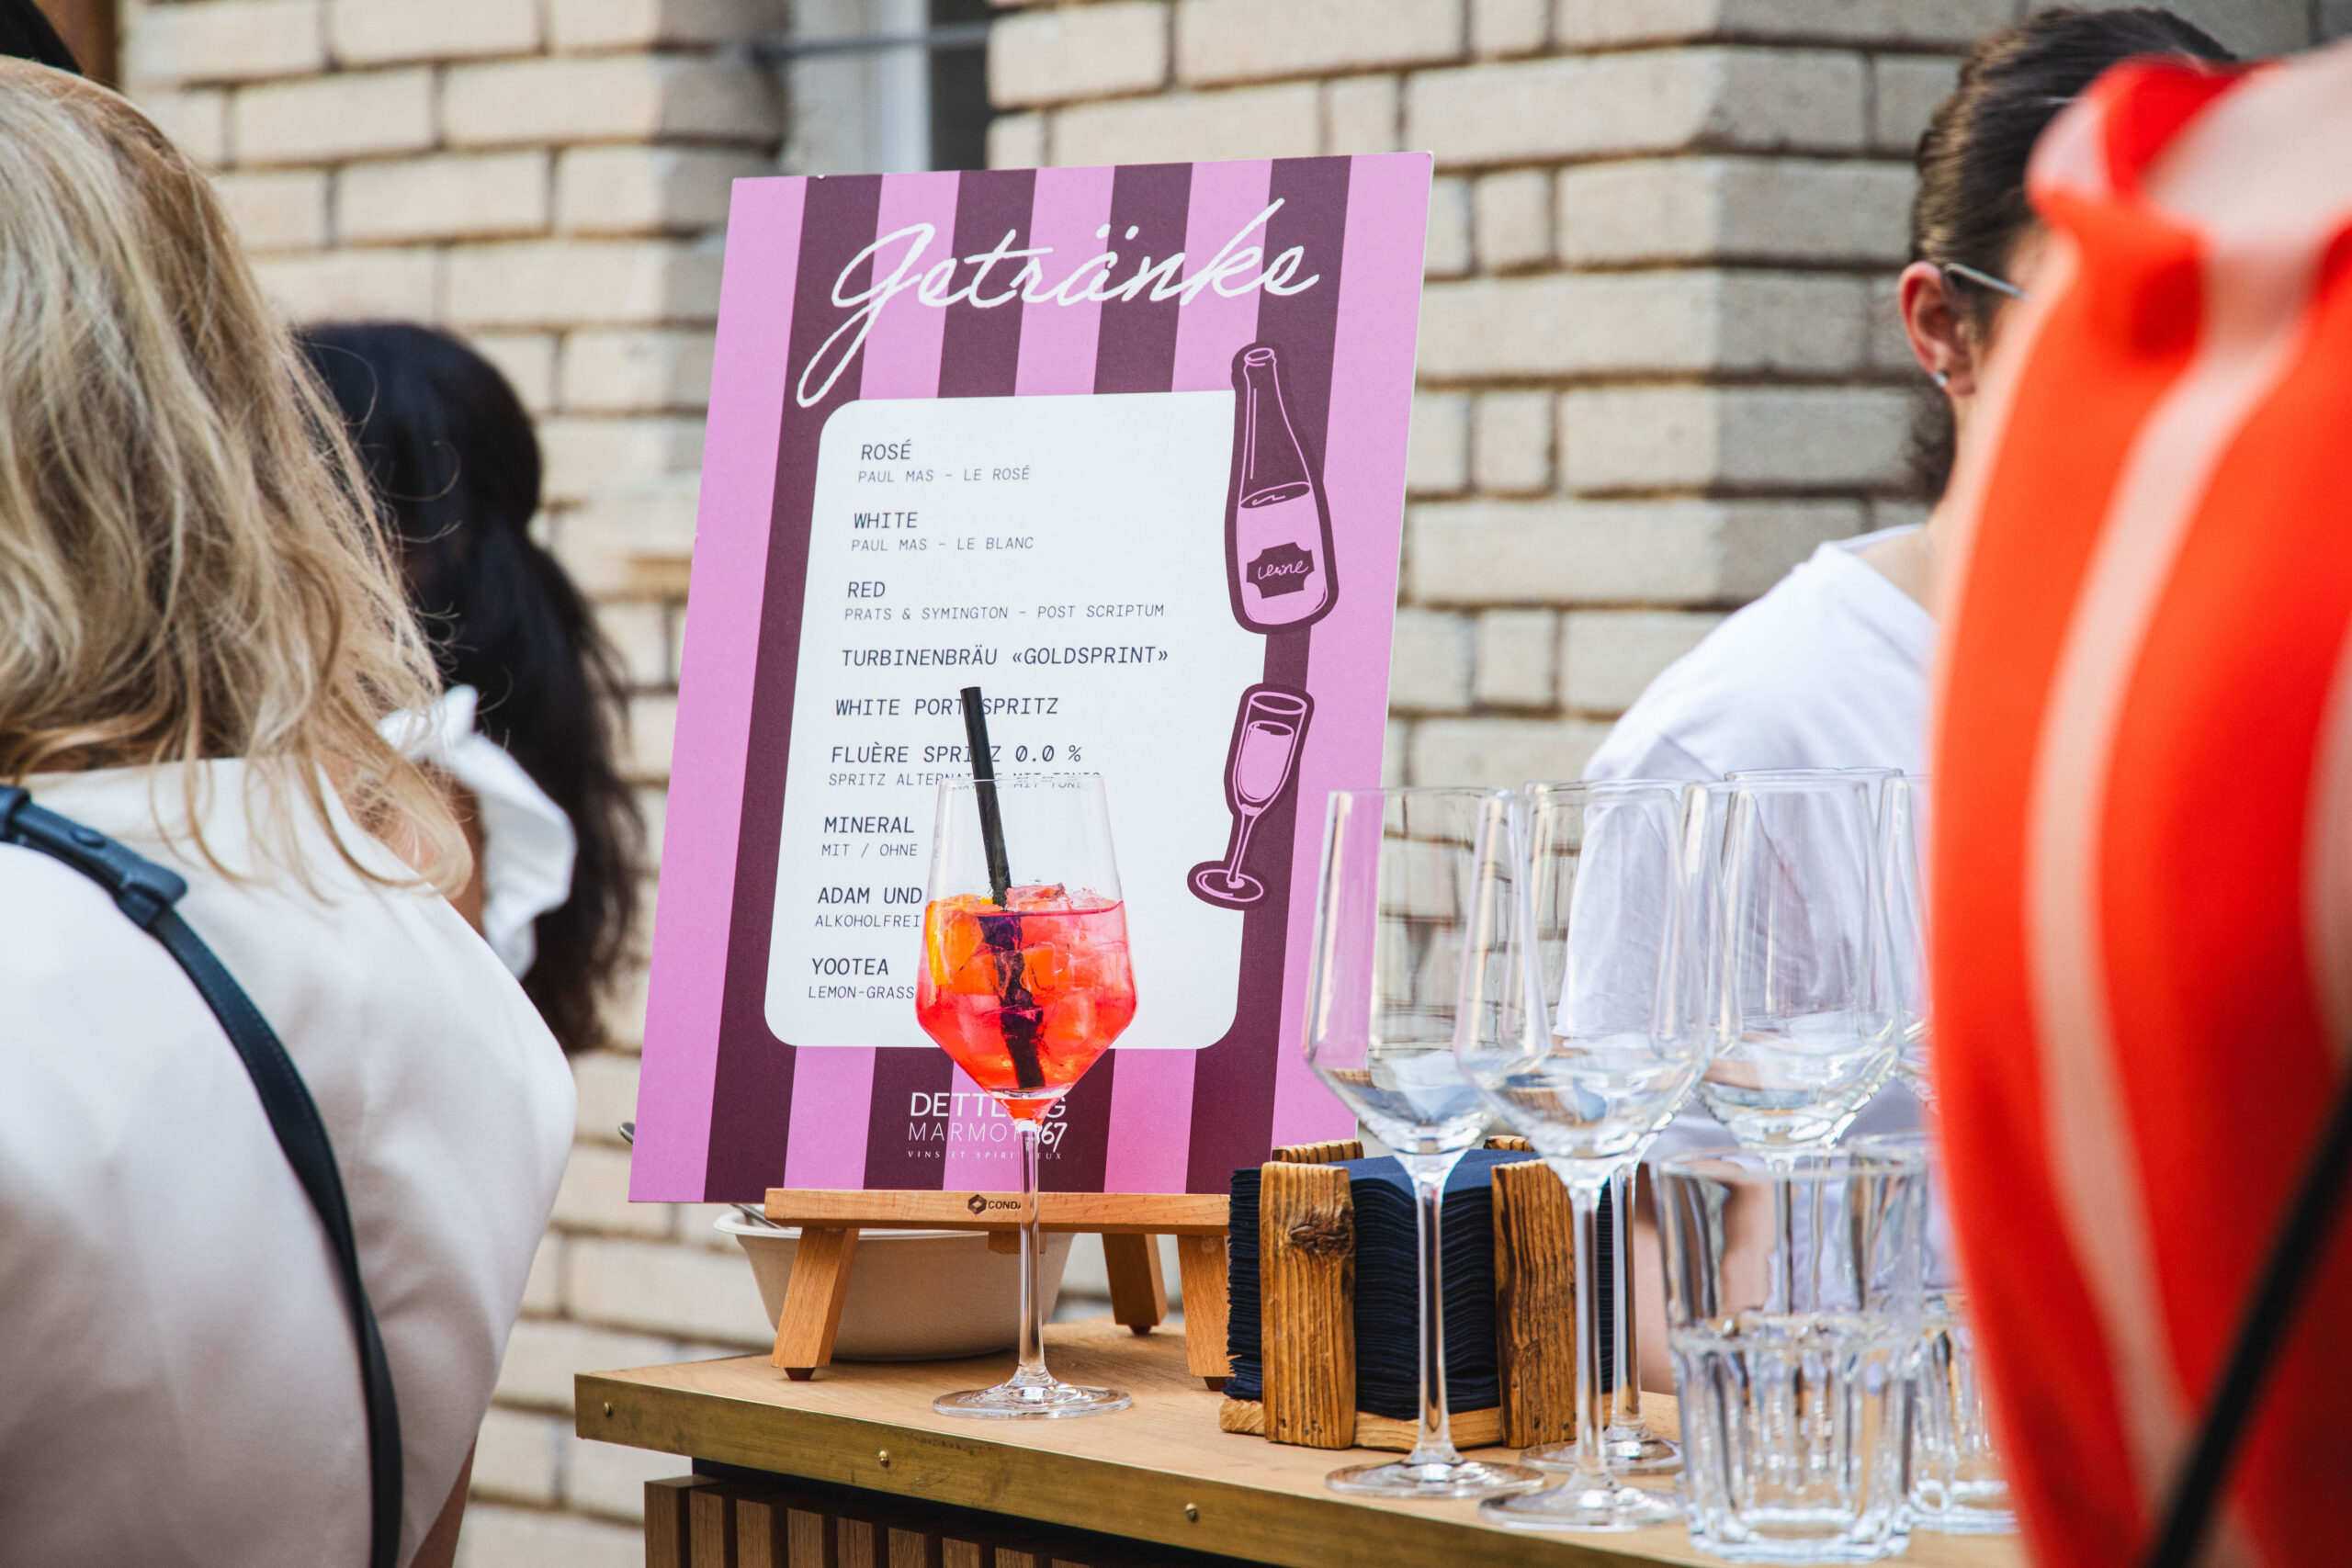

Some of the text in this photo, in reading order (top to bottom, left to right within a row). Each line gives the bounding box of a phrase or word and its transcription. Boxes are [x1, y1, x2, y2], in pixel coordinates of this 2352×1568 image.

[797, 197, 1319, 408] Getränke
[861, 439, 911, 460] ROSÉ
[859, 471, 894, 482] PAUL
[906, 469, 933, 481] MAS
[965, 468, 981, 480] LE
[993, 465, 1029, 479] ROSÉ
[854, 512, 918, 529] WHITE
[852, 539, 888, 551] PAUL
[899, 538, 926, 550] MAS
[957, 538, 975, 550] LE
[986, 536, 1034, 549] BLANC
[848, 581, 886, 598] RED
[845, 608, 891, 620] PRATS
[902, 608, 910, 620] &
[922, 606, 1008, 619] SYMINGTON
[1038, 605, 1075, 618] POST
[1087, 604, 1164, 617] SCRIPTUM
[842, 644, 1168, 666] TURBINENBRÄU «GOLDSPRINT»
[836, 696, 1059, 716] WHITE PORT SPRITZ
[832, 741, 1081, 763] FLUÈRE SPRIZ 0.0 %
[829, 773, 886, 785] SPRITZ
[824, 817, 914, 833] MINERAL
[822, 843, 918, 857] MIT / OHNE
[818, 887, 922, 904] ADAM UND
[815, 915, 921, 927] ALKOHOLFREI
[812, 958, 888, 976] YOOTEA
[808, 986, 914, 998] LEMON-GRASS
[910, 1092, 1066, 1118] DETTLG
[977, 1152, 1061, 1160] SPIRIEUX
[988, 1201, 1021, 1210] COND
